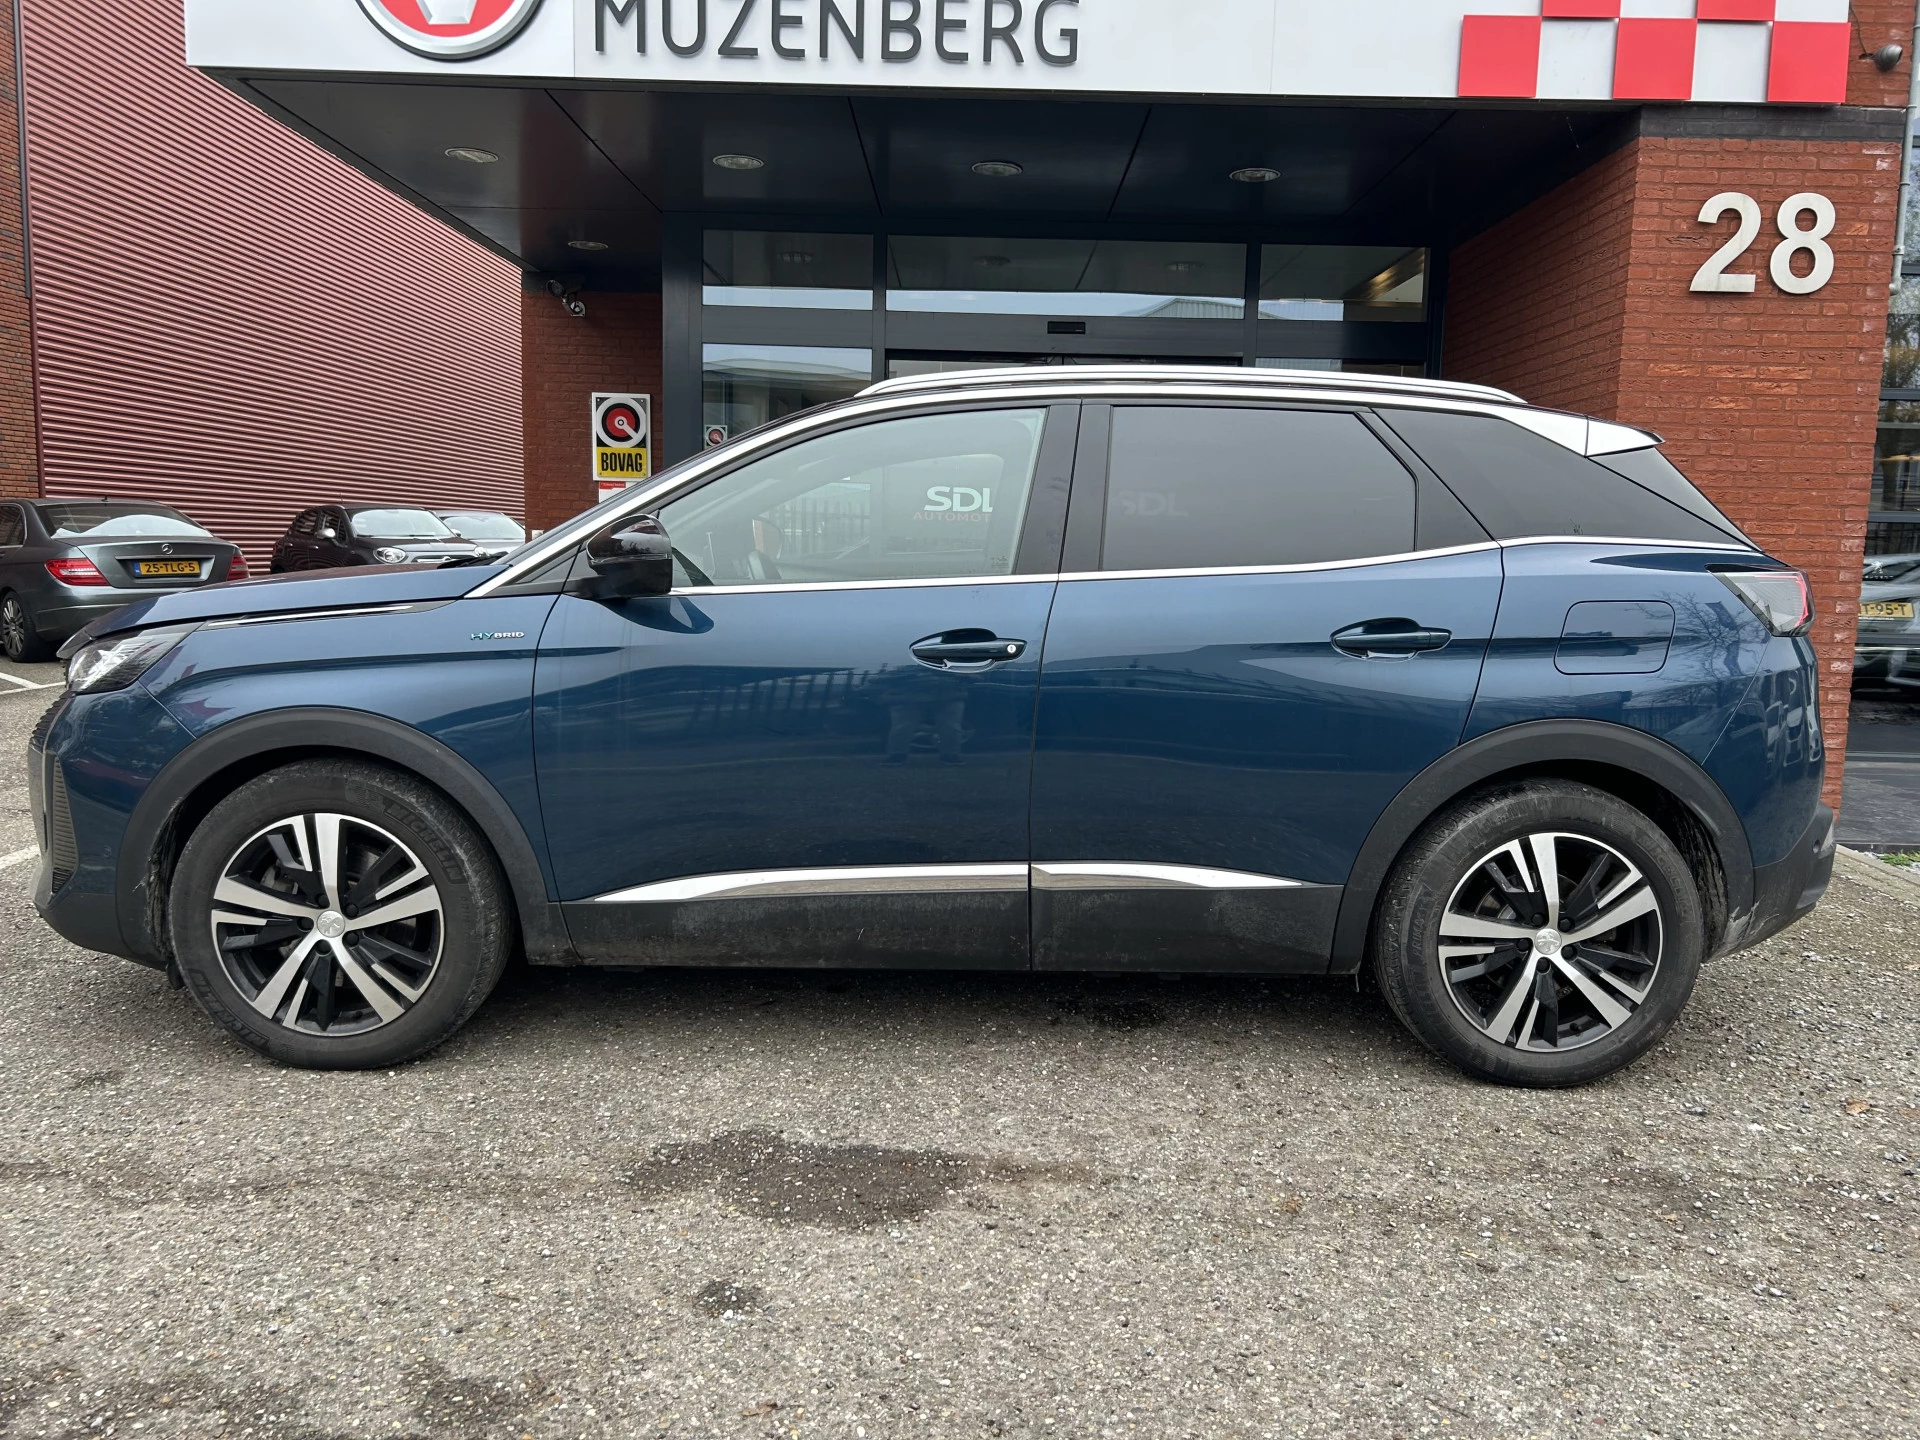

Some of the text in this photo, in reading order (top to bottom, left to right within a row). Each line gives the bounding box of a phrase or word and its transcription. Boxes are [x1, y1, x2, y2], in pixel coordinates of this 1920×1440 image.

[595, 0, 1079, 64] MUZENBERG
[1689, 192, 1836, 294] 28
[601, 452, 643, 472] BOVAG
[145, 563, 196, 573] 25-TLG-5
[1860, 603, 1907, 616] T-95-T
[470, 631, 525, 640] HYBRID
